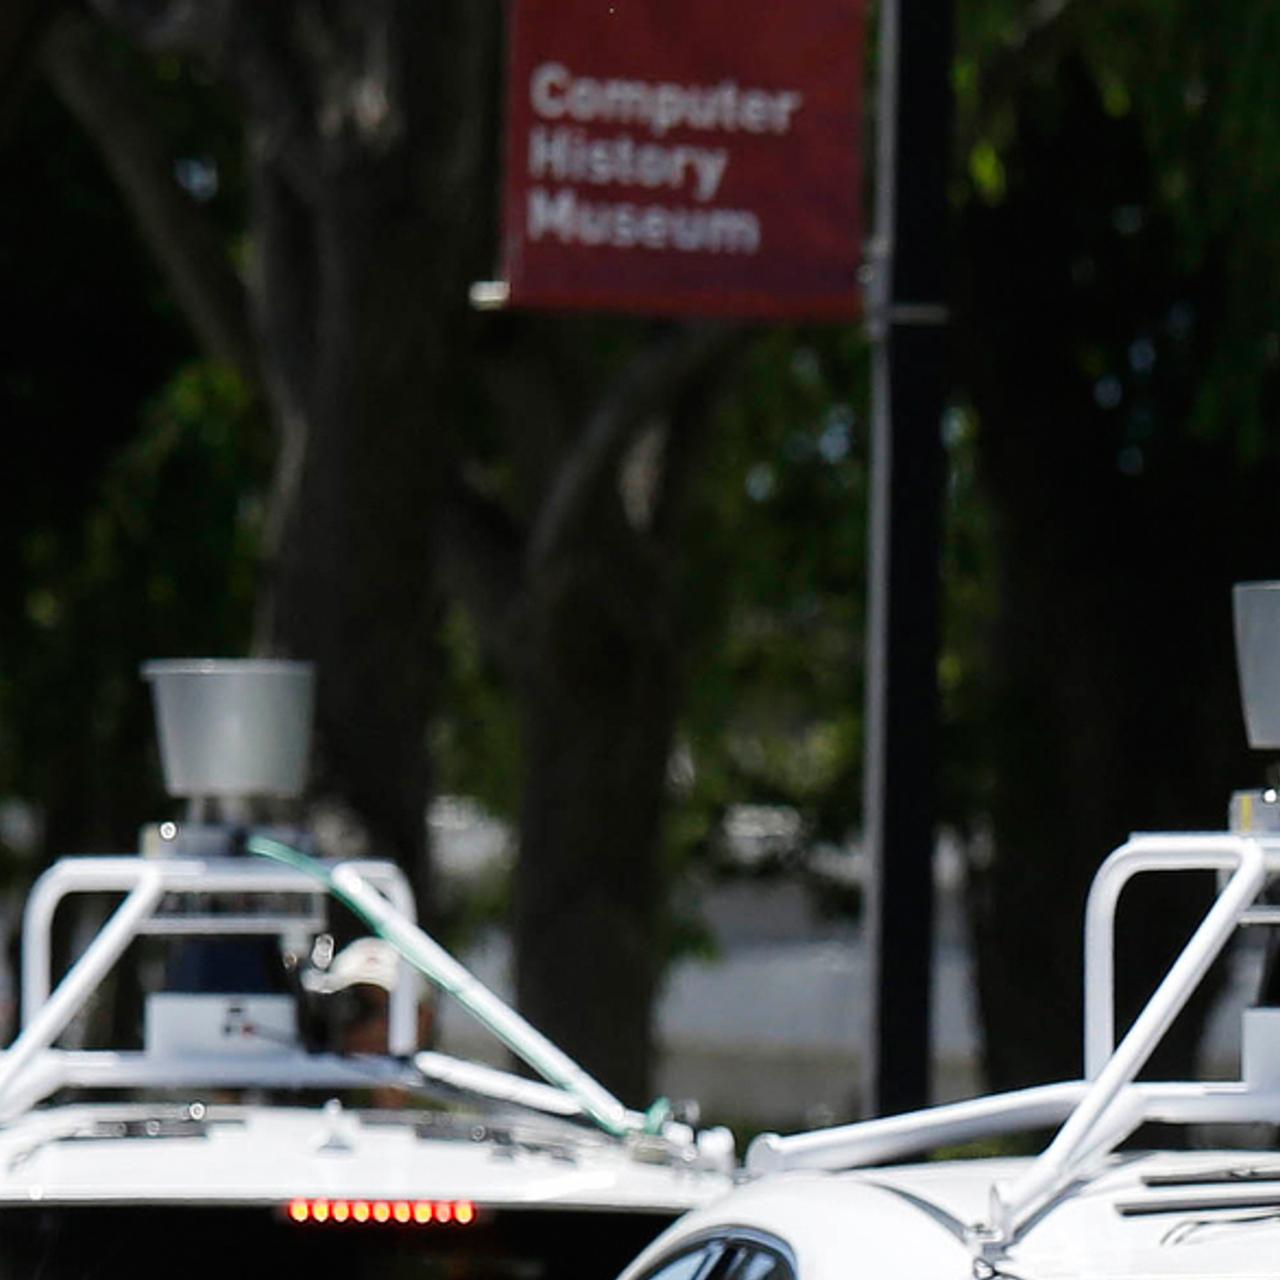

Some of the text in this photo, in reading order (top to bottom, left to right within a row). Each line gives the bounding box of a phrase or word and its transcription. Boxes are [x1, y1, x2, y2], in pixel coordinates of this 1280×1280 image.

[530, 61, 802, 134] Computer
[527, 127, 728, 201] History
[526, 190, 762, 254] Museum
